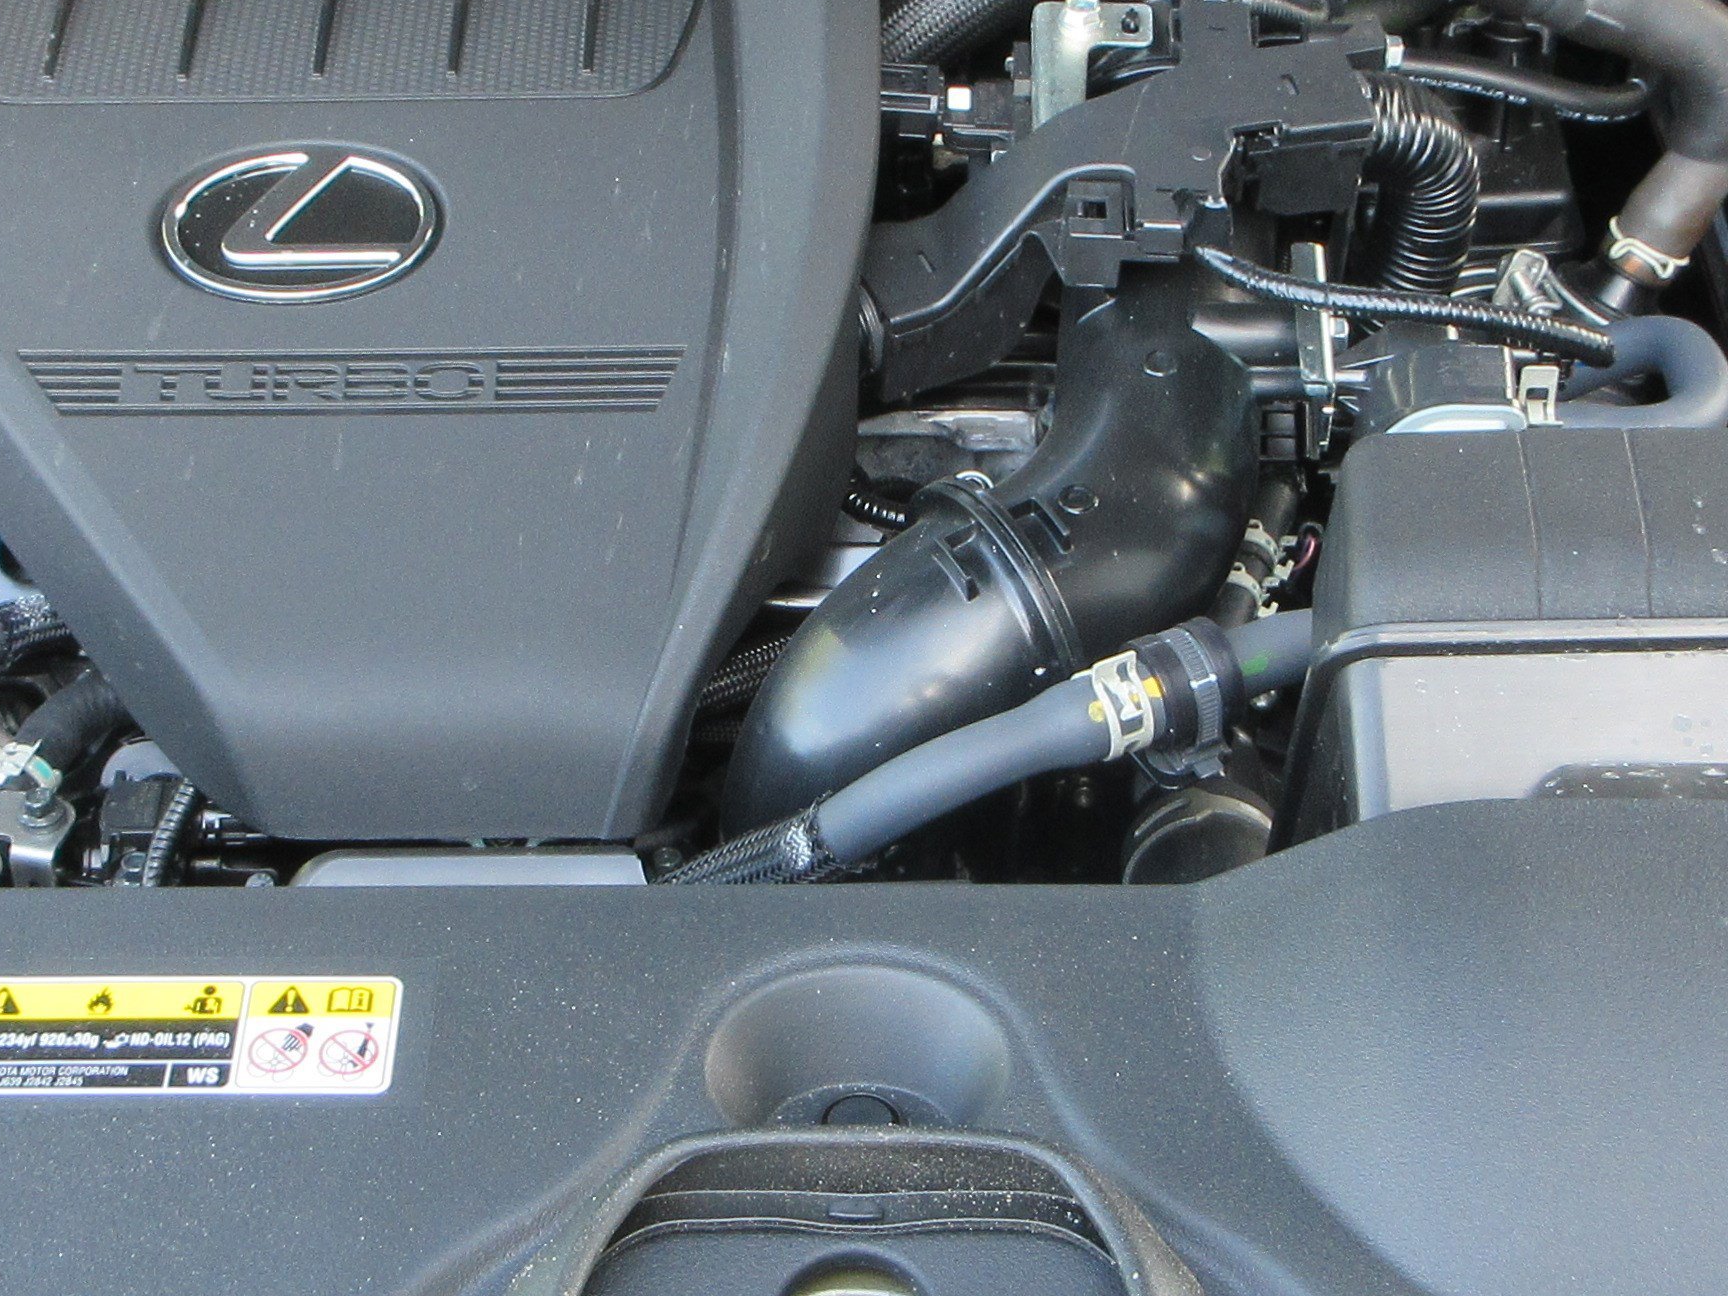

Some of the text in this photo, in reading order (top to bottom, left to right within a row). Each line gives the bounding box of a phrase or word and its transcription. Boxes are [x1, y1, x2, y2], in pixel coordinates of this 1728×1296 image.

[132, 360, 485, 402] TURBO
[193, 1032, 231, 1049] (PAG)
[20, 1066, 57, 1077] MOTOR
[58, 1066, 129, 1077] CORPORATION
[186, 1067, 220, 1084] WS
